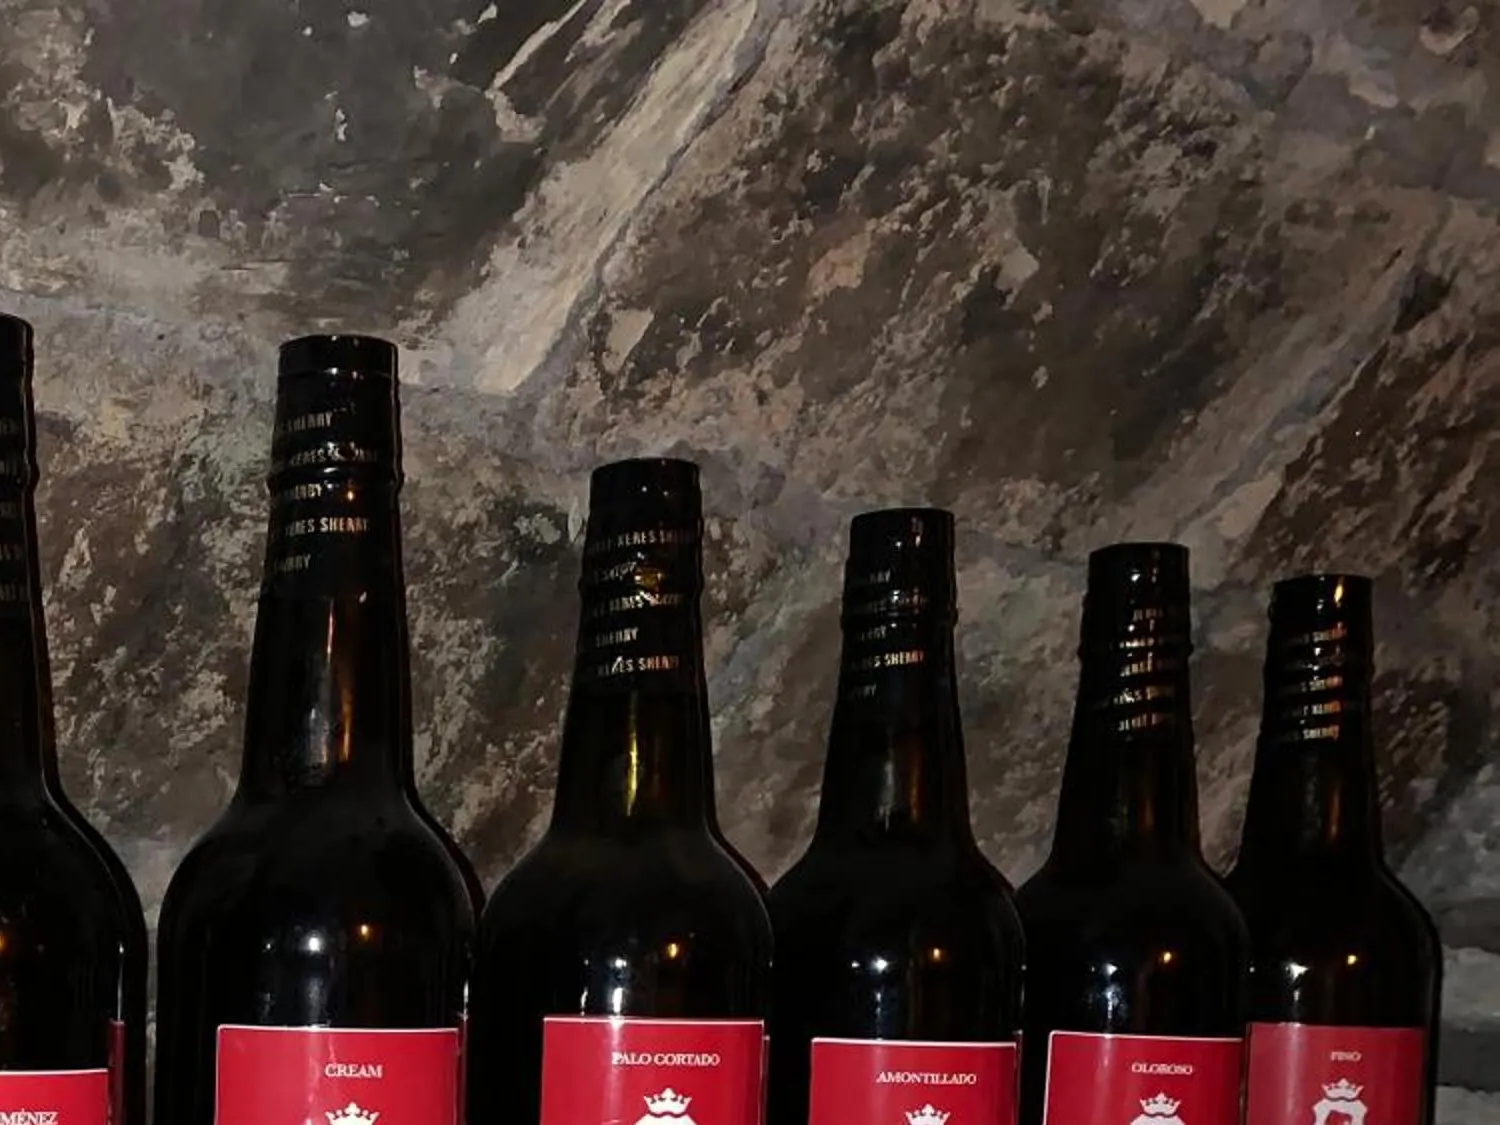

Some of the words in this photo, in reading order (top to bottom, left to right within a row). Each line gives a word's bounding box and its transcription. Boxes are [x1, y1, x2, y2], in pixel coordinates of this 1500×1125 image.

[611, 1052, 652, 1066] PALO
[654, 1054, 720, 1066] CORTADO
[324, 1062, 382, 1078] CREAM
[876, 1070, 976, 1084] AMONTILLADO
